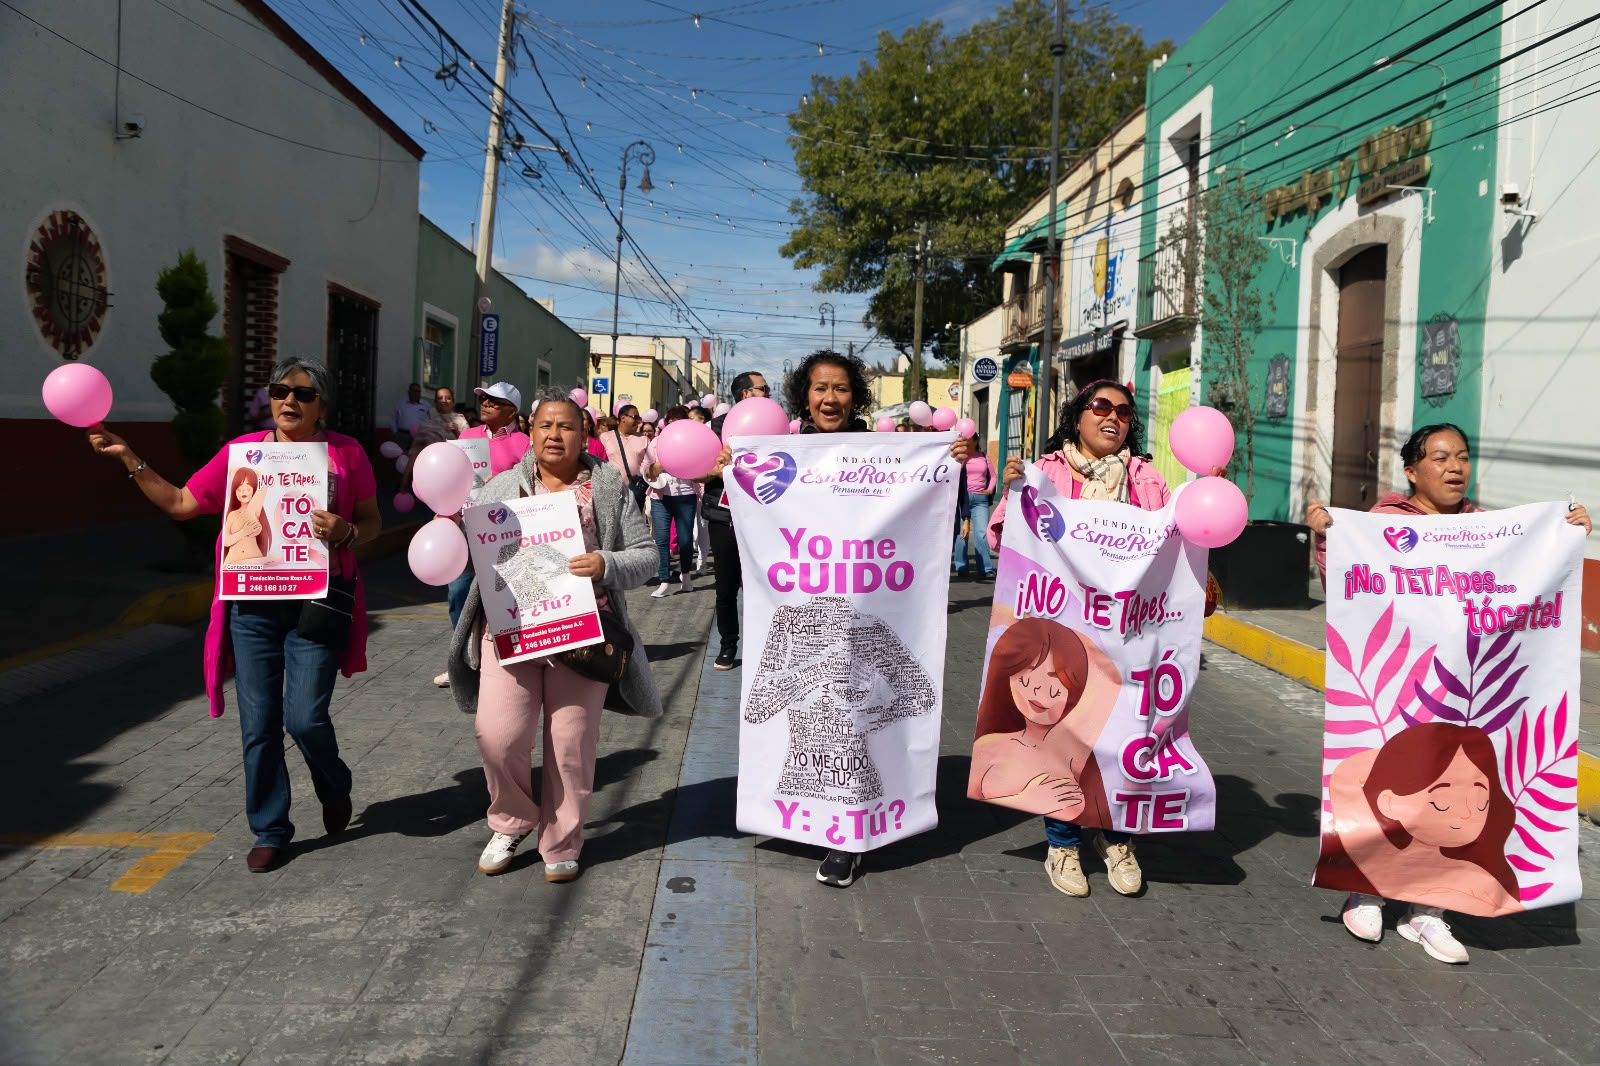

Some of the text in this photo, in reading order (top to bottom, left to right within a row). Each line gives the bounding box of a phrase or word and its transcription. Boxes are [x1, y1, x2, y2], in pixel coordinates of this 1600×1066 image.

[488, 333, 496, 372] VIRTUALES
[830, 484, 870, 494] Pensando
[282, 493, 311, 515] TÓ
[282, 521, 312, 539] CA
[477, 528, 521, 545] Yo me
[519, 527, 576, 548] CUIDO
[1094, 518, 1158, 535] FUNDACI
[1422, 524, 1524, 542] EsmeRoss A.C.
[282, 546, 308, 562] TE
[779, 527, 896, 560] Yo me
[767, 560, 915, 595] CUIDO
[1345, 564, 1386, 600] ¡No
[531, 594, 572, 617] ¿Tú?
[1017, 574, 1066, 616] ¡NO
[1463, 591, 1563, 637] tócate!
[552, 635, 561, 643] 10
[561, 633, 571, 641] 27
[792, 752, 869, 772] YO ME CUIDO
[1122, 727, 1193, 780] CA
[1115, 792, 1186, 828] TE
[825, 799, 906, 845] ¿Tú?
